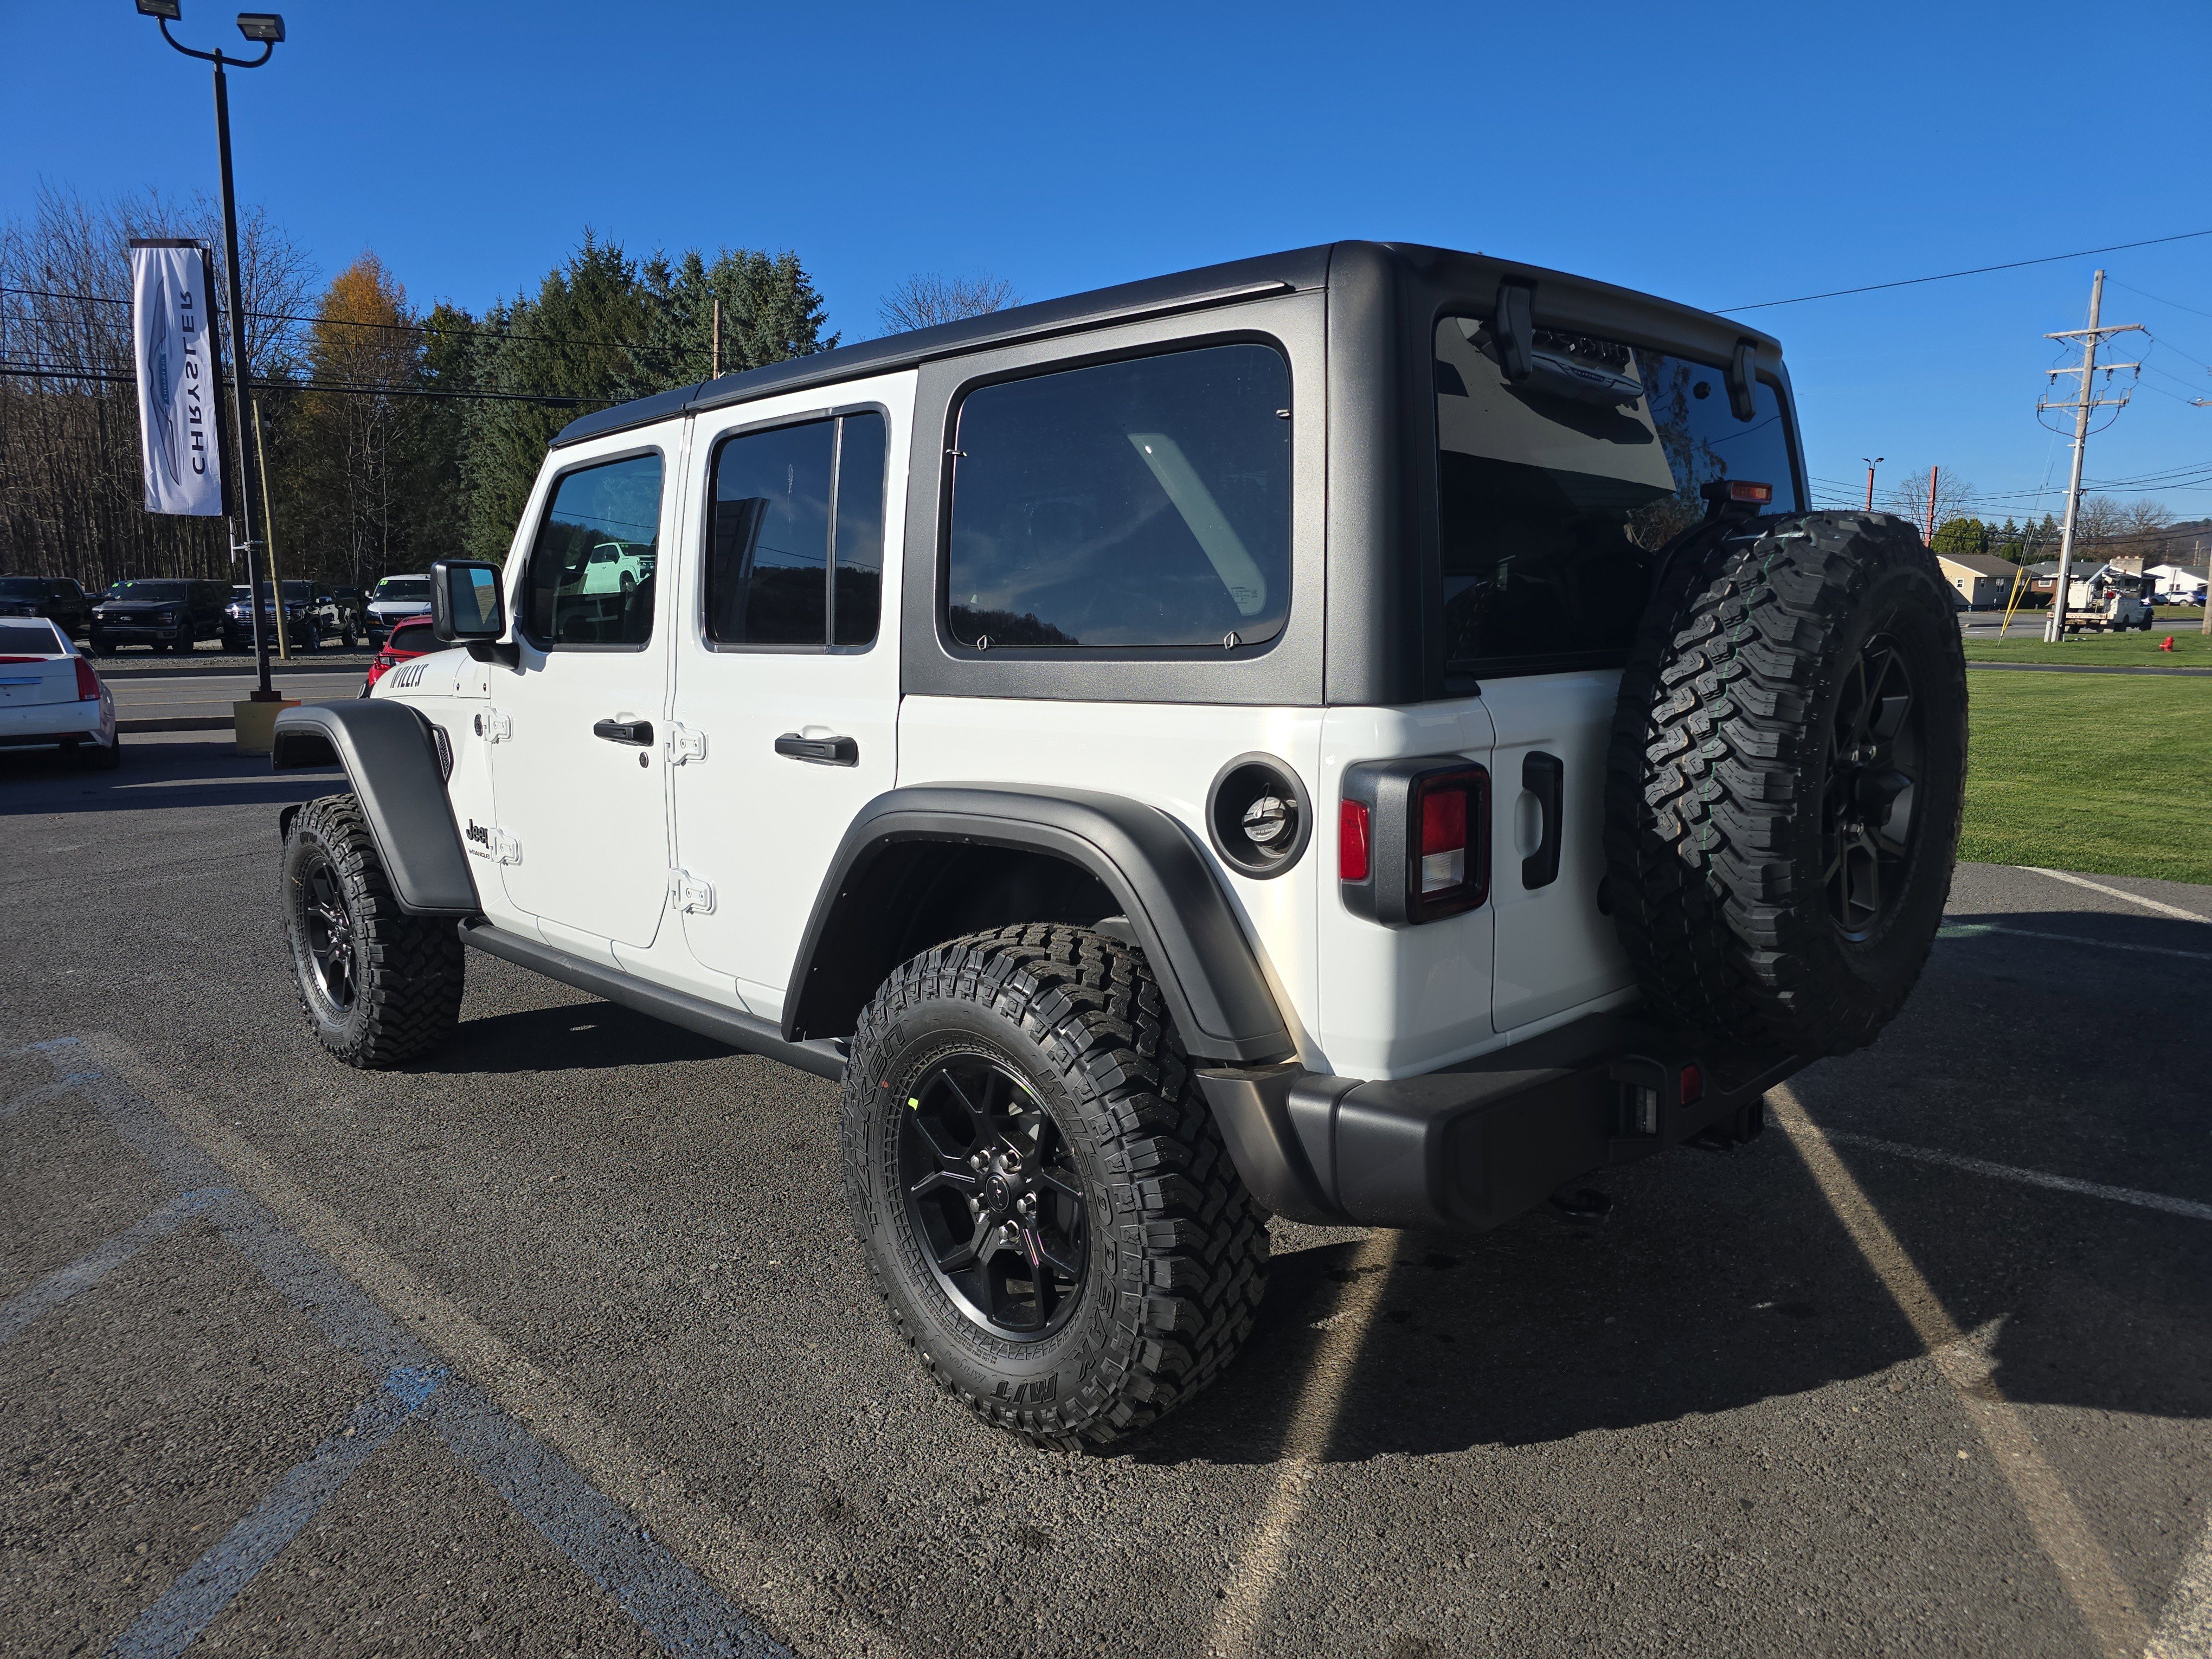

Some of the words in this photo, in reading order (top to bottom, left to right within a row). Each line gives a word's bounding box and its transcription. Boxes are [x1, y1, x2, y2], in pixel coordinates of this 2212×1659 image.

[390, 663, 429, 689] WILLYS
[468, 848, 490, 859] WRANGLE
[894, 1235, 903, 1252] RADIAL
[895, 1248, 906, 1270] THAILAND
[901, 1252, 911, 1270] BELTED
[910, 1271, 919, 1285] STEEL
[992, 1370, 1058, 1404] M/T
